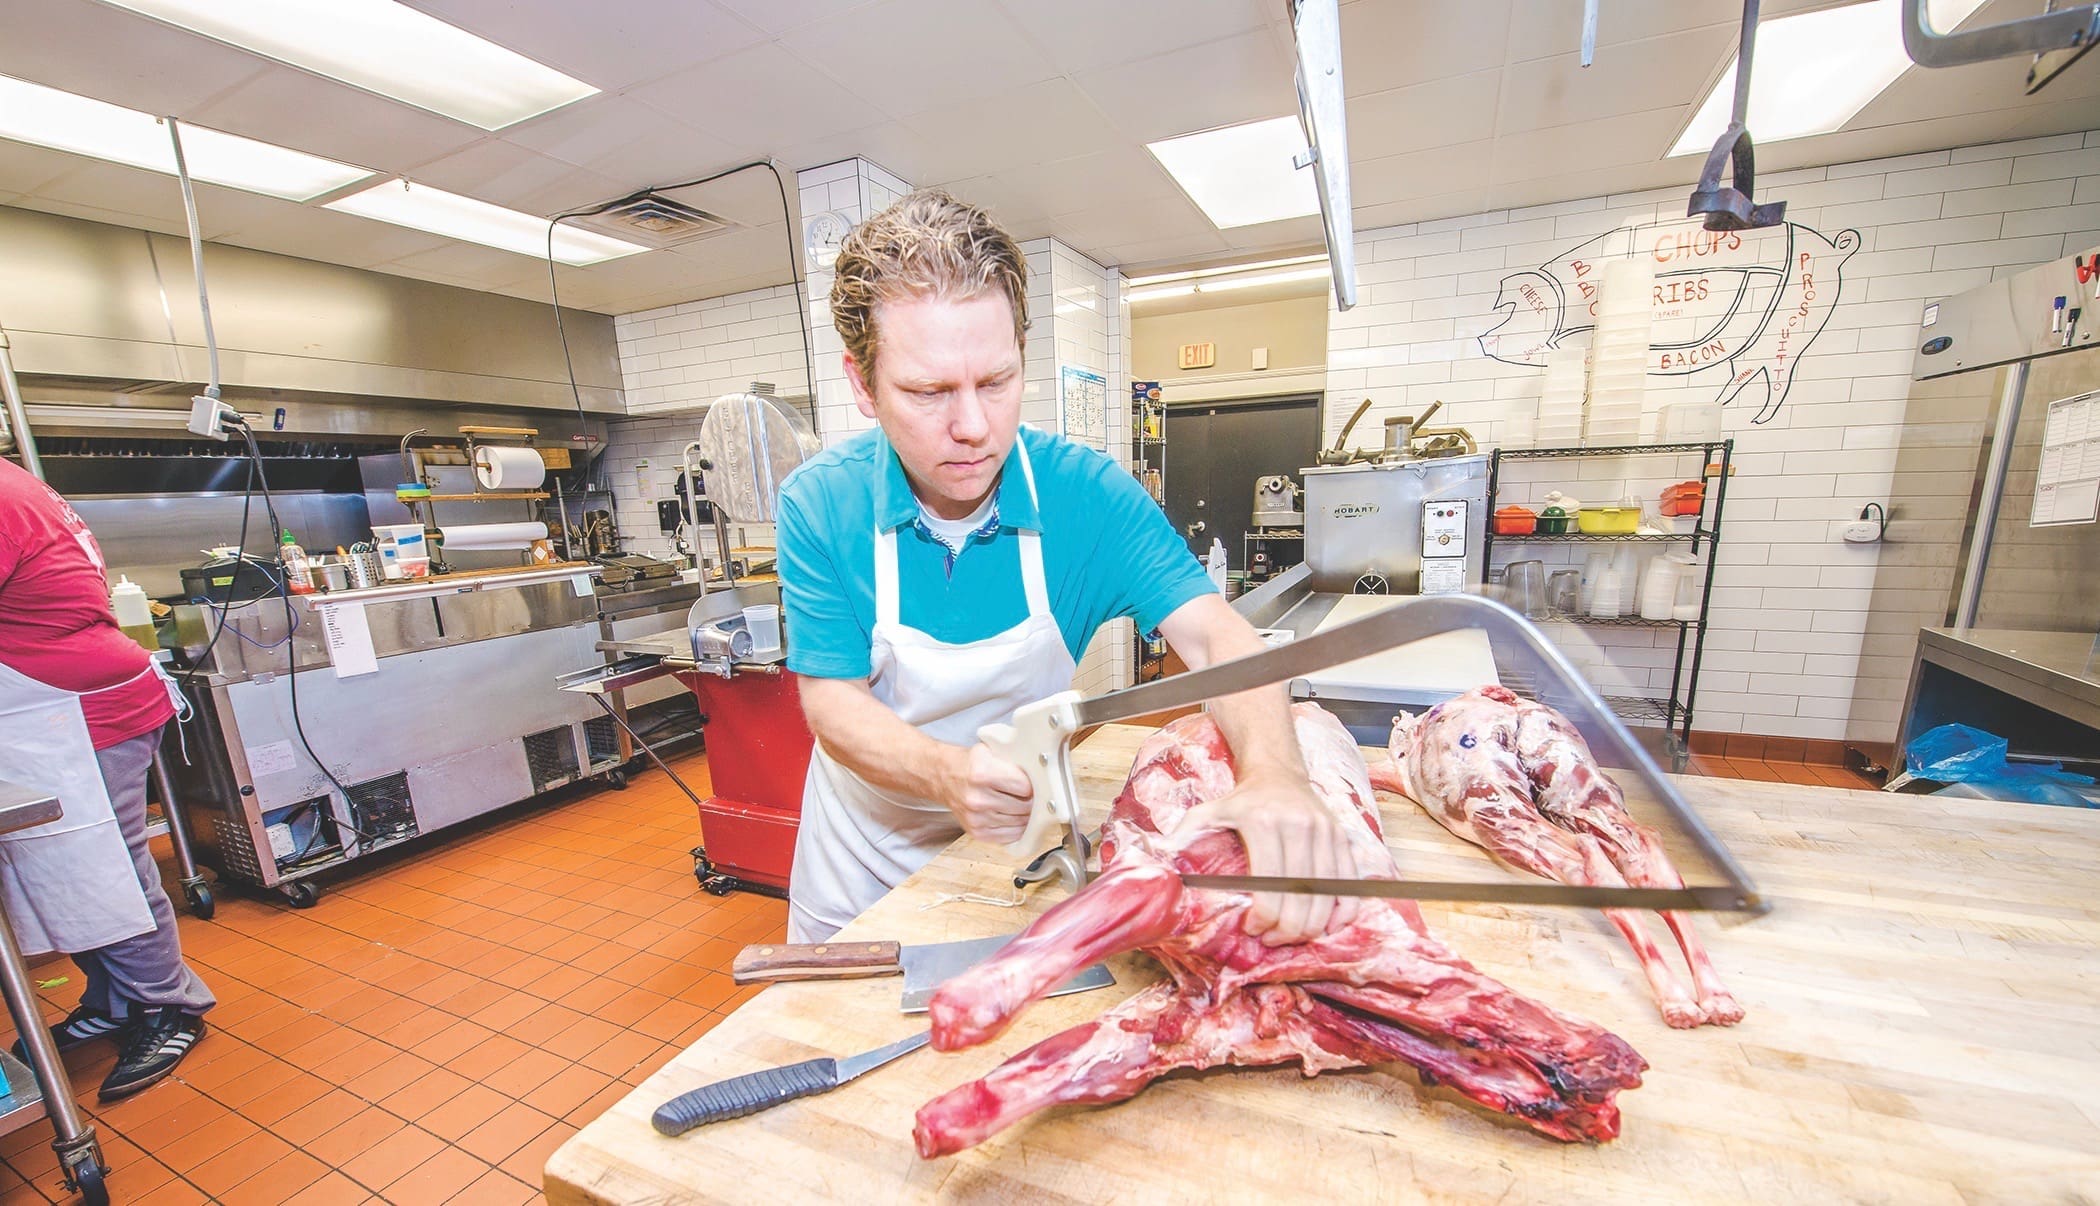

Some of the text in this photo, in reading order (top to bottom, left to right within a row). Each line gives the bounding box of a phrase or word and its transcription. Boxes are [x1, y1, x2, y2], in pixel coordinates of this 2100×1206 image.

[1654, 230, 1741, 262] CHOPS
[1520, 283, 1548, 315] CHEESE
[1653, 278, 1709, 306] RIBS
[1184, 343, 1210, 366] EXIT
[1661, 340, 1726, 369] BACON
[1734, 368, 1755, 385] SHANK
[1334, 506, 1374, 515] HOBART
